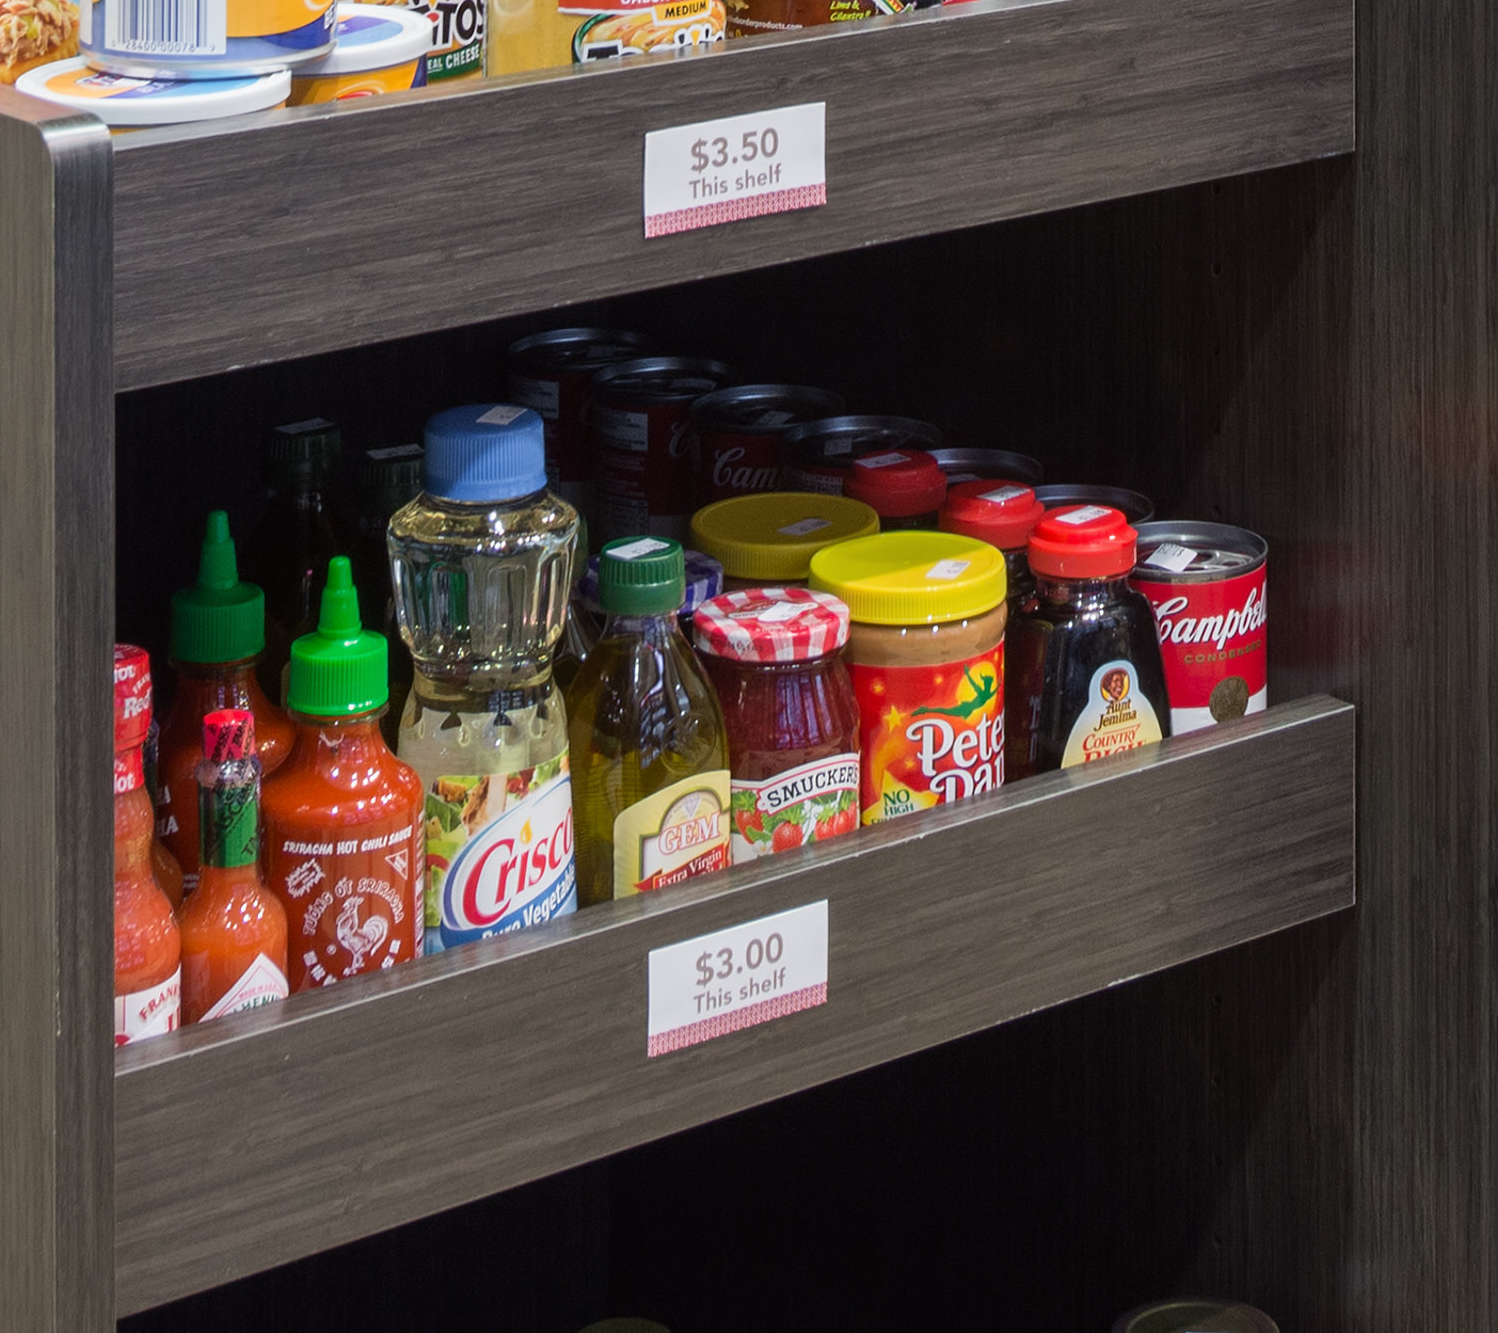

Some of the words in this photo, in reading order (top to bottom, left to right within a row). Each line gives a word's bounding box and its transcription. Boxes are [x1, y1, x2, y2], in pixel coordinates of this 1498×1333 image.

[690, 127, 779, 173] $3.50
[689, 176, 729, 199] This
[735, 163, 782, 192] shelf
[1093, 709, 1137, 732] Jemima
[883, 789, 911, 806] NO
[883, 802, 915, 816] HIGH
[283, 840, 334, 857] SRIRACHA
[336, 840, 358, 855] HOT
[361, 837, 388, 853] CHILI
[658, 810, 721, 856] GEM
[463, 807, 573, 927] Crisco
[695, 932, 783, 988] $3.00
[693, 987, 732, 1014] This
[739, 966, 787, 1001] shelf
